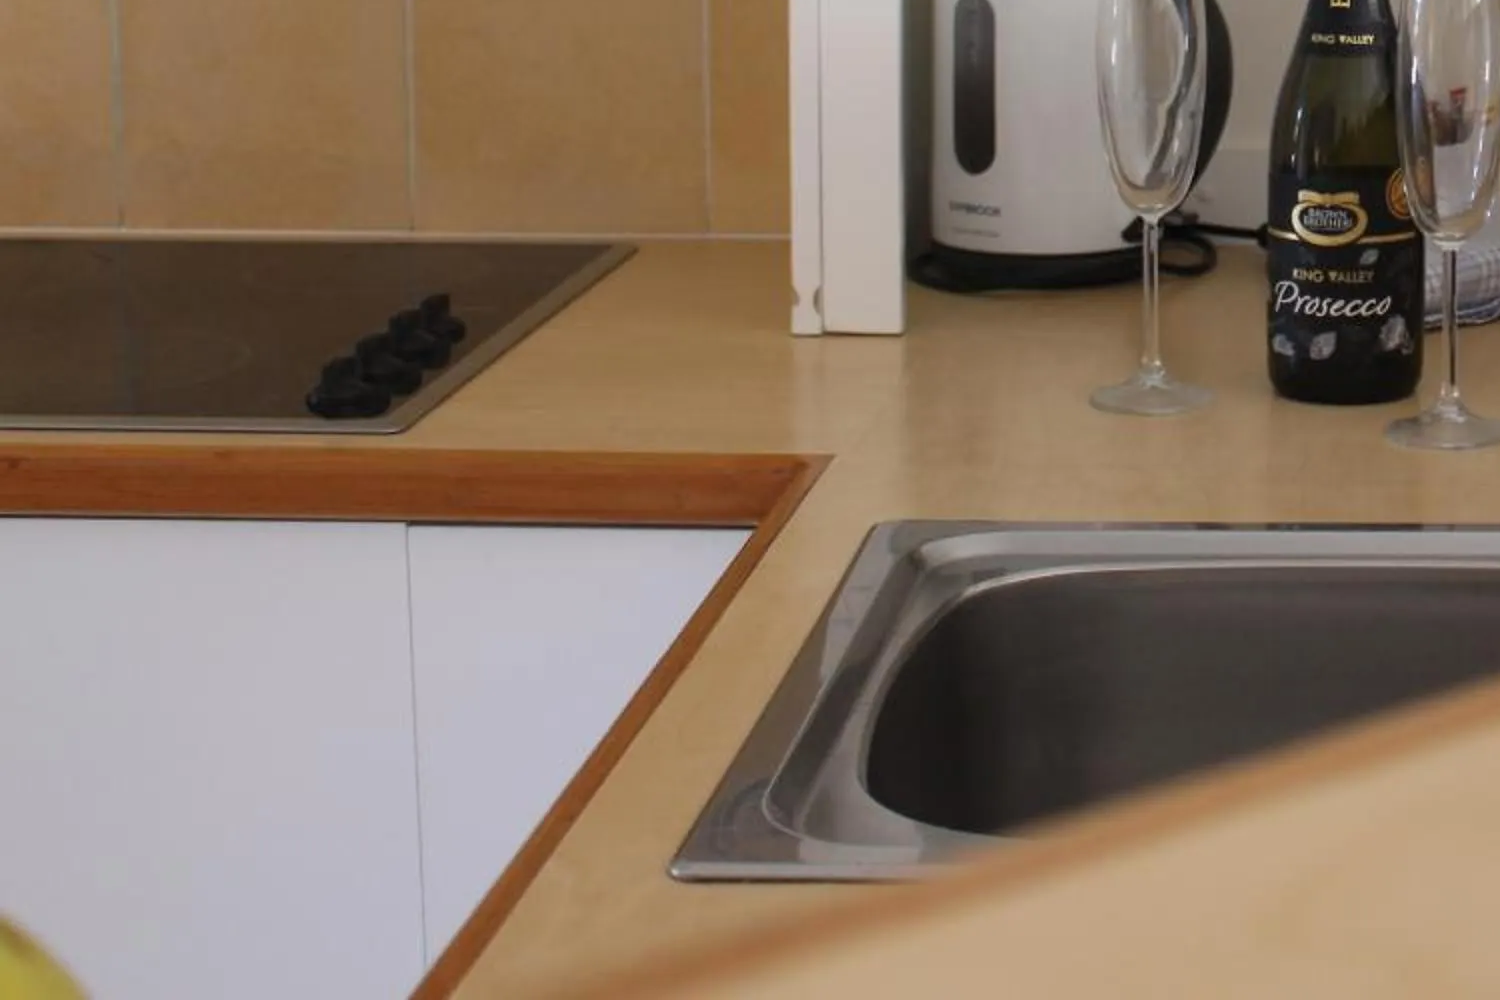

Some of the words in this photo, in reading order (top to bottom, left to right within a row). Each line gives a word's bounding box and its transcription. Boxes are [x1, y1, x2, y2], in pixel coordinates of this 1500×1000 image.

[1339, 34, 1375, 46] VALLEY
[1292, 267, 1325, 283] KING
[1328, 269, 1375, 284] VALLEY
[1274, 280, 1392, 318] Prosecco
